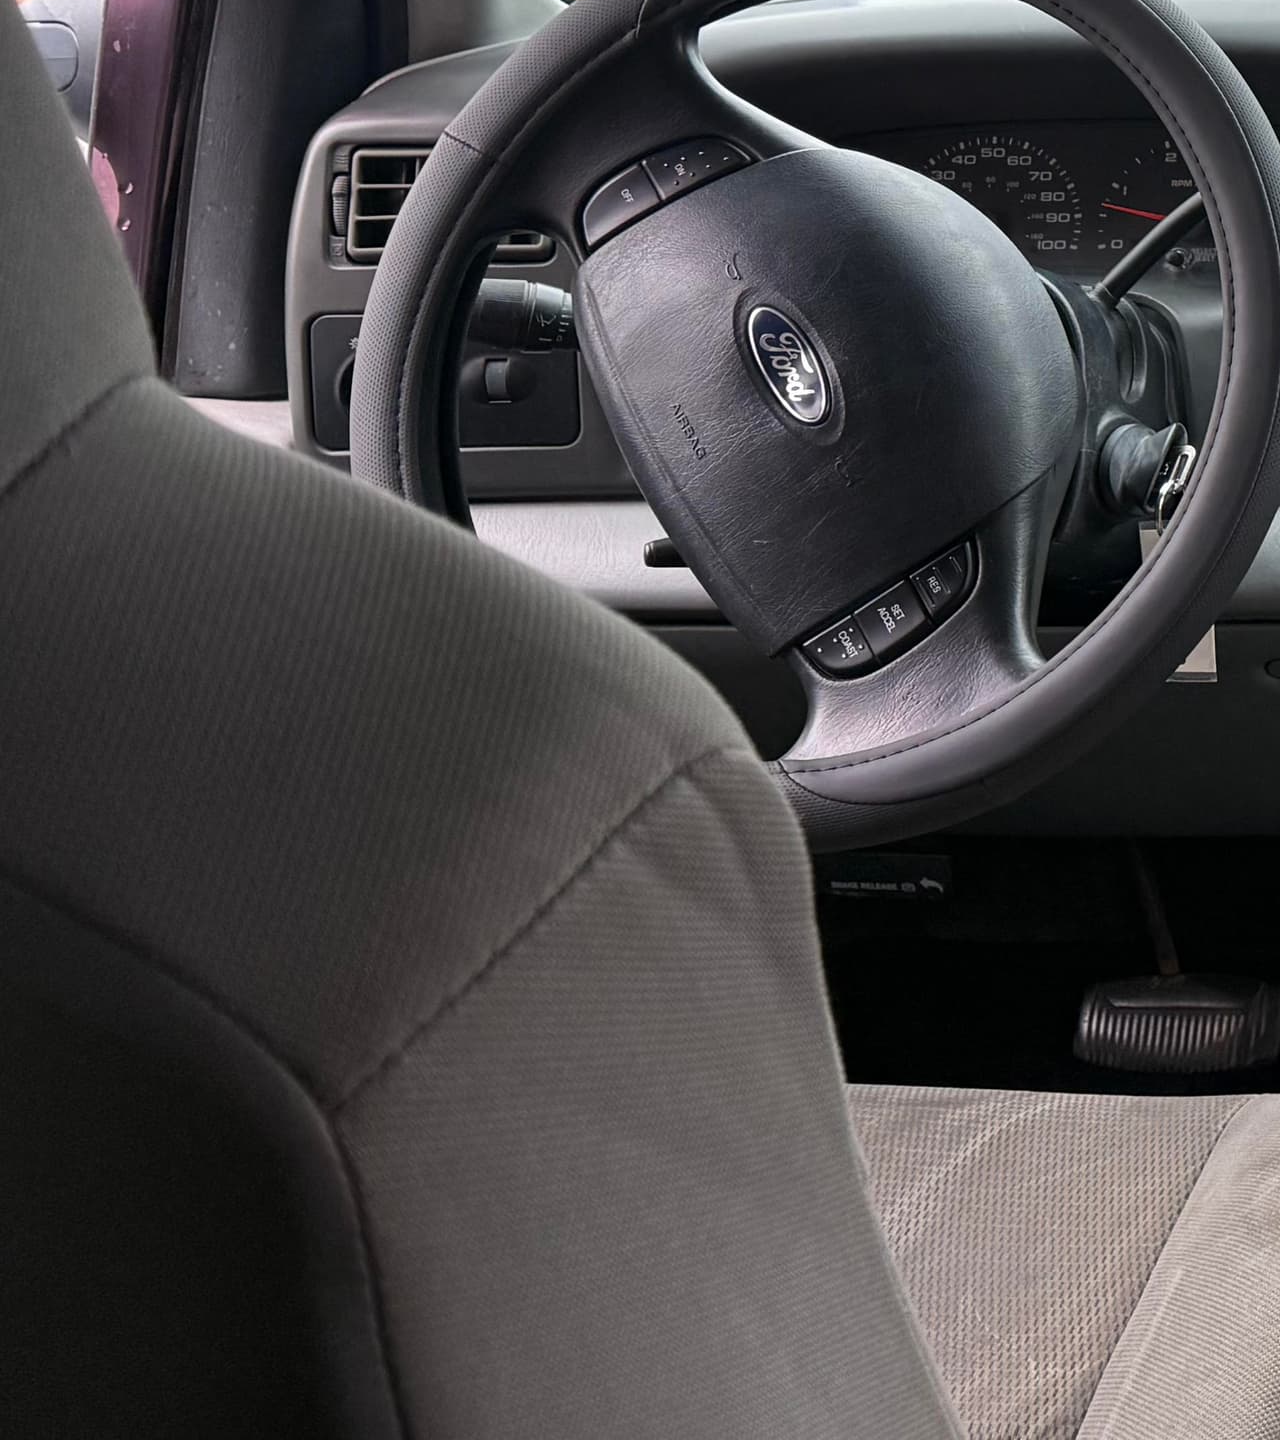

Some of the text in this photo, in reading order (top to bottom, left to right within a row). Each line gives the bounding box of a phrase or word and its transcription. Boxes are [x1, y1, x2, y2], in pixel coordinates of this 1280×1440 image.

[980, 147, 1006, 158] 50
[1165, 152, 1177, 162] 2
[951, 155, 977, 165] 40
[1007, 155, 1032, 166] 60
[674, 163, 687, 177] ON
[931, 170, 956, 181] 30
[1028, 171, 1052, 181] 70
[1171, 179, 1193, 188] RPM
[620, 188, 635, 203] OFF
[1123, 185, 1128, 196] 1
[1040, 192, 1065, 202] 80
[1045, 213, 1070, 223] 90
[1037, 240, 1066, 250] 100
[759, 332, 816, 402] Ford
[670, 403, 707, 460] AIRBAG
[927, 575, 941, 594] RES
[890, 603, 905, 620] SET
[877, 607, 896, 633] ACCEL
[838, 630, 858, 657] COAST
